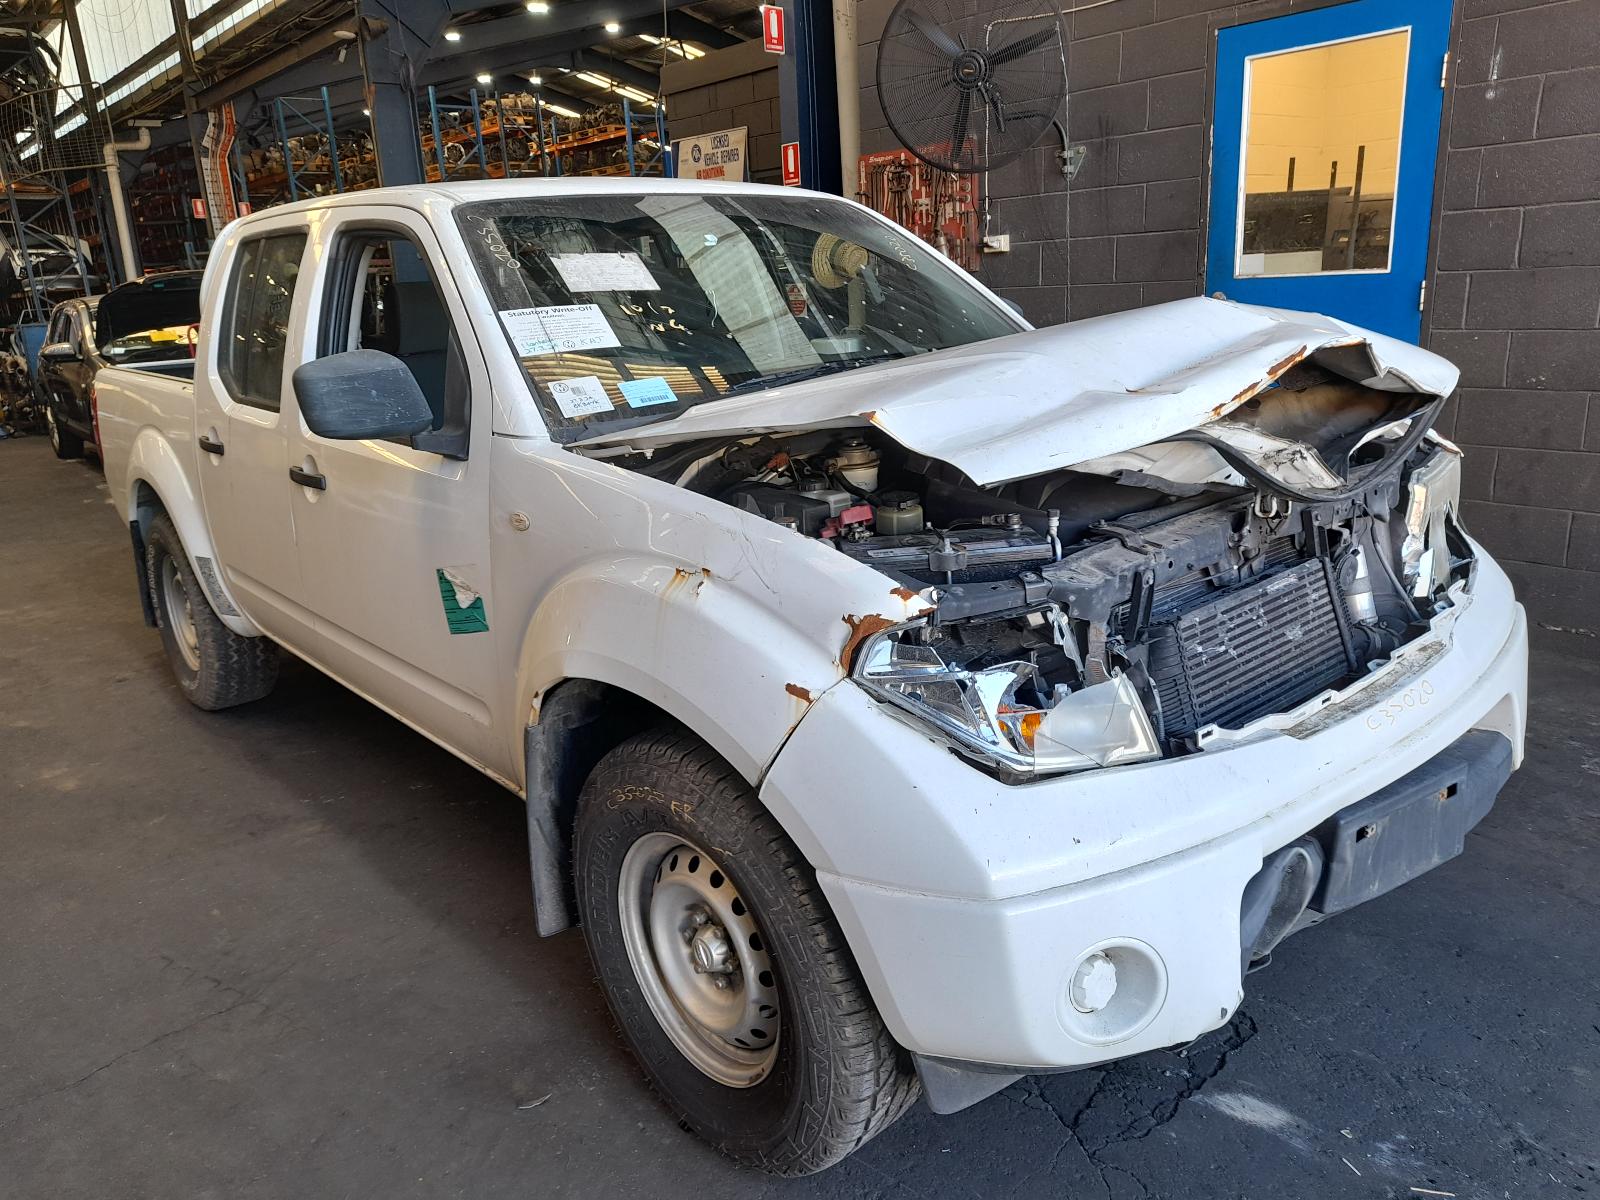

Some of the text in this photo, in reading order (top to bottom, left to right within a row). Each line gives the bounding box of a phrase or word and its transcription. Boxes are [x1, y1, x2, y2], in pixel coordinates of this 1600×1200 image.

[710, 134, 730, 150] LICENSED
[704, 152, 720, 166] VEHICLE
[720, 148, 740, 164] REPAIRER
[507, 309, 549, 319] Statutory
[551, 305, 593, 314] Write-Off
